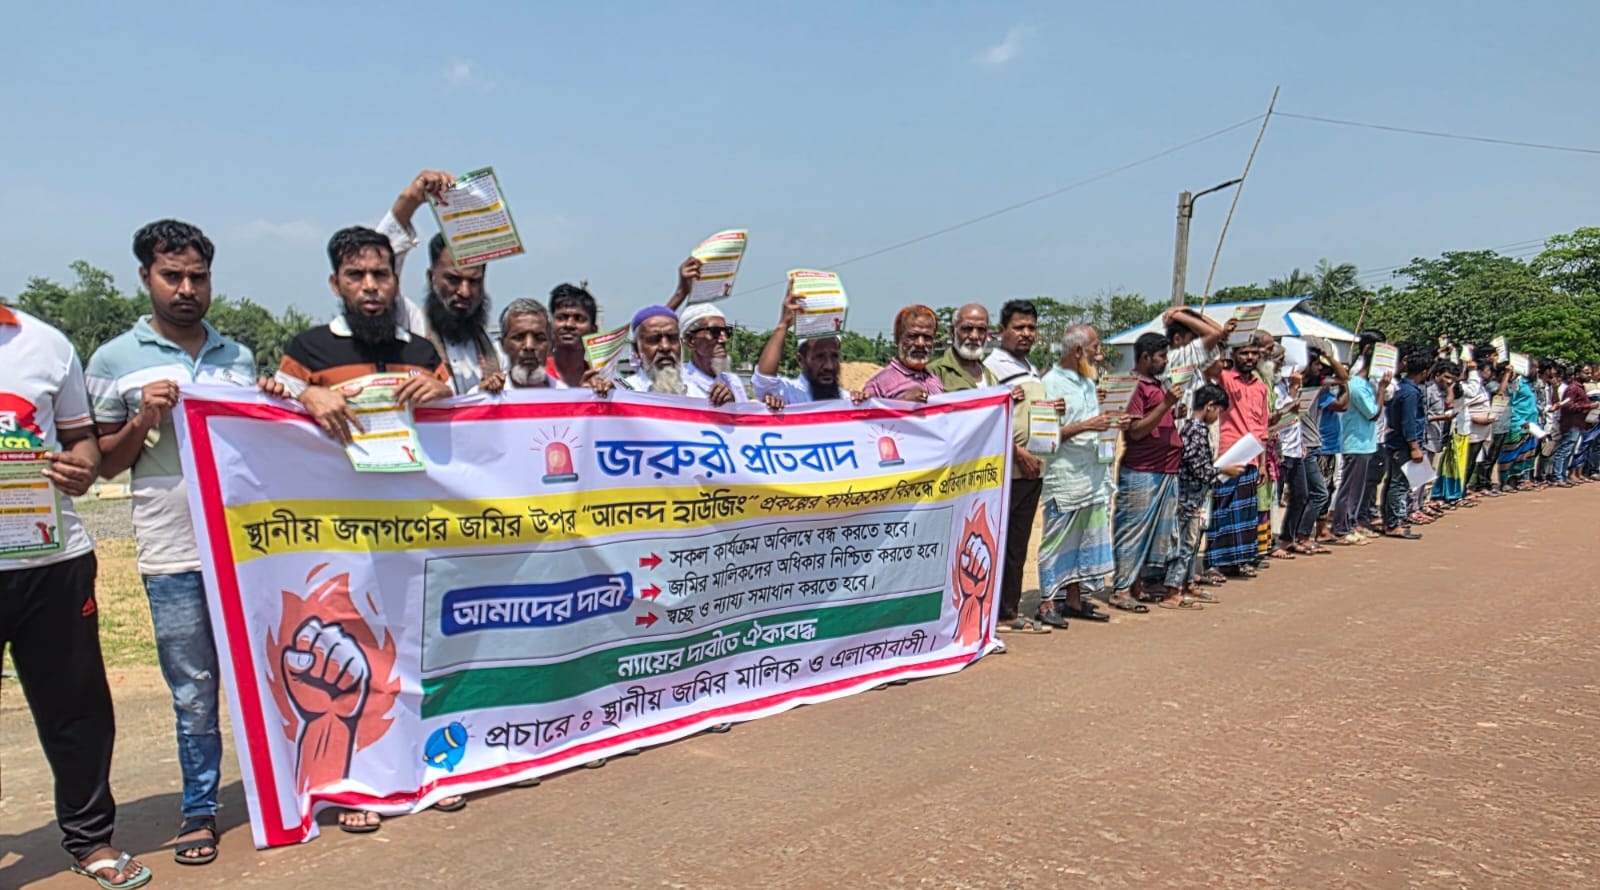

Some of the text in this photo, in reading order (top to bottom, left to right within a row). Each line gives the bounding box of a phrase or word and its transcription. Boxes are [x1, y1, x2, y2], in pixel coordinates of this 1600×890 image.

[594, 430, 859, 479] জরুরী প্রতিবাদ
[242, 508, 323, 554] স্থানীয়
[330, 515, 450, 543] জনগণের
[456, 507, 523, 540] জমির
[527, 505, 577, 534] উপর
[760, 495, 823, 512] প্রকল্পের
[826, 485, 894, 508] কার্যক্রমের
[938, 471, 967, 496] প্রতিবাদ
[666, 571, 709, 597] জমির
[712, 563, 773, 588] মালিকদের
[777, 551, 827, 574] অধিকার
[830, 545, 874, 569] নিশ্চিত
[877, 546, 915, 563] করতে
[668, 546, 710, 568] সকল
[713, 533, 761, 560] কার্যক্রম
[763, 527, 814, 550] অবিলম্বে
[817, 526, 838, 544] বন্ধ
[841, 524, 881, 542] করতে
[452, 577, 626, 625] আমাদের দাবী
[665, 605, 696, 625] স্বচ্ছ
[699, 602, 709, 617] ও
[713, 592, 745, 614] ন্যায্য
[748, 583, 795, 605] সমাধান
[798, 577, 839, 597] করতে
[617, 618, 819, 677] ন্যায়ের দাবীতে ঐক্যবদ্ধ
[485, 714, 575, 750] প্রচারে
[600, 685, 666, 728] স্থানীয়
[672, 670, 729, 704] জমির
[736, 656, 802, 690] মালিক
[808, 656, 824, 672] ও
